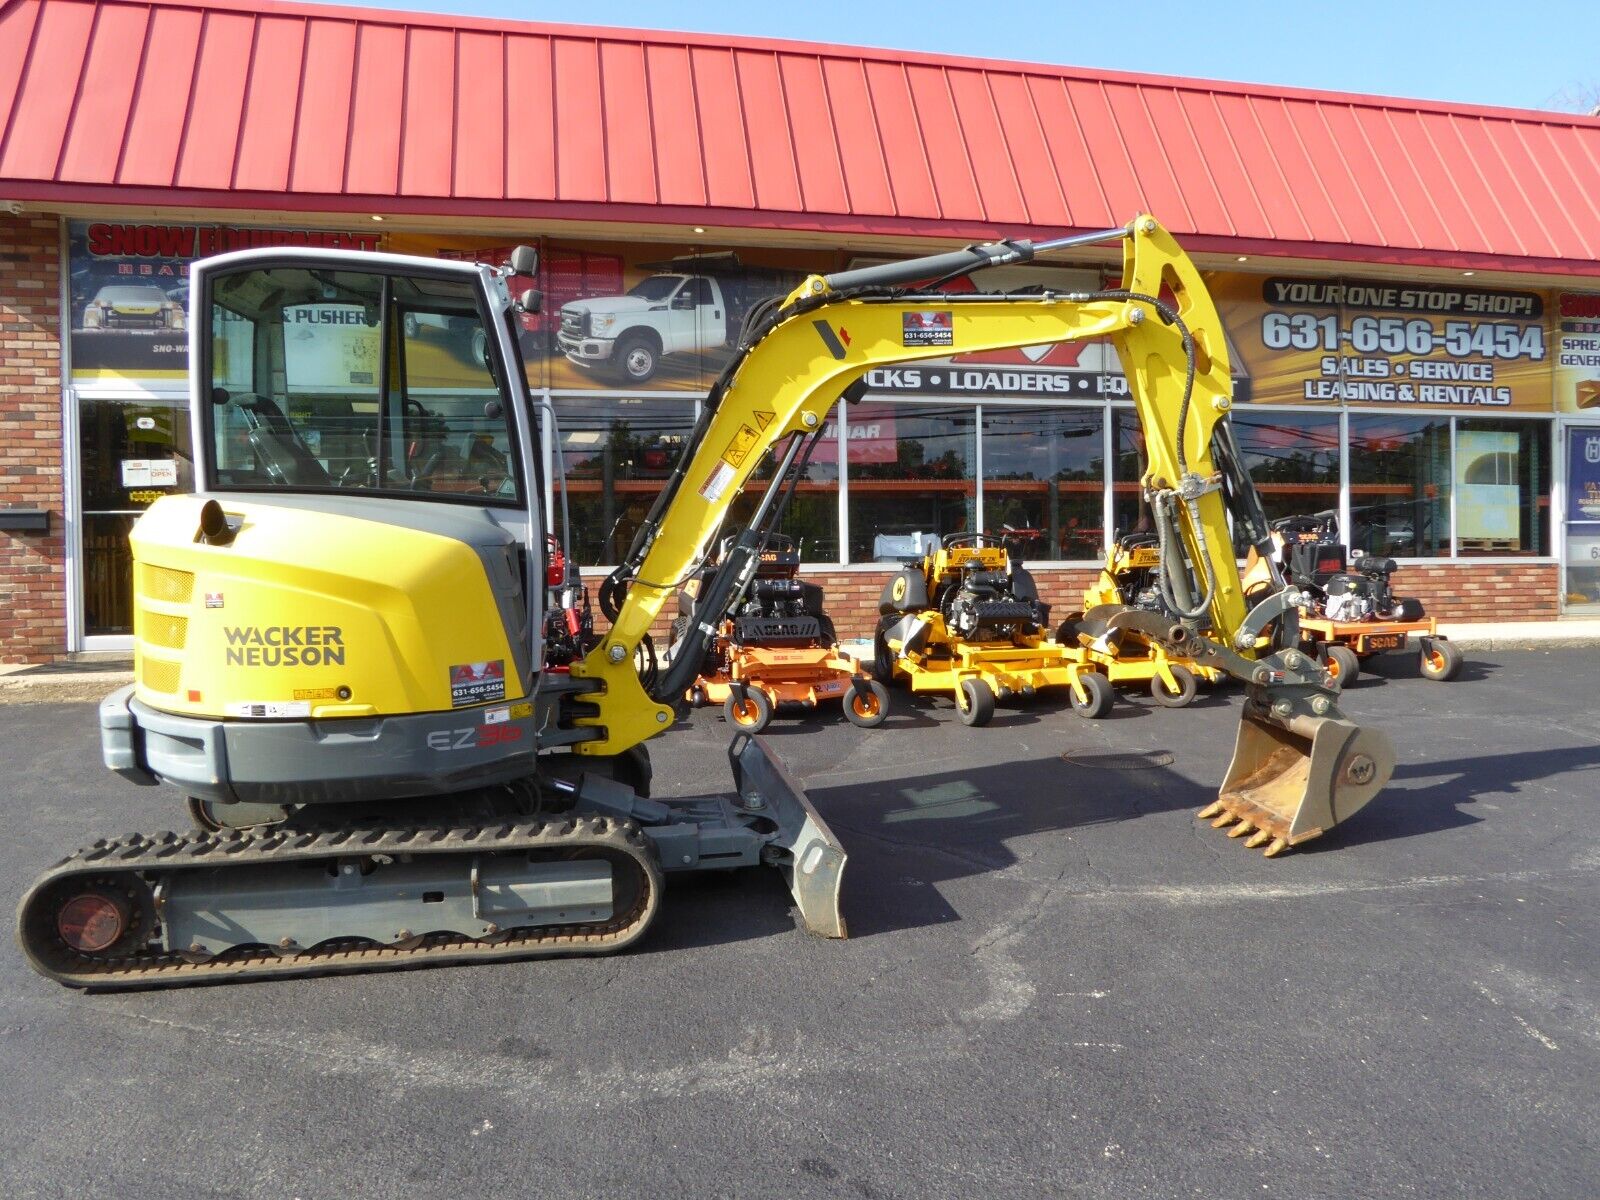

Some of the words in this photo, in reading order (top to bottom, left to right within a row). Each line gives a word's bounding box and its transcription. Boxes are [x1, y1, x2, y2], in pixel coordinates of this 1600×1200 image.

[88, 222, 196, 257] SNOW
[1274, 283, 1345, 304] YOUR
[1347, 287, 1397, 307] ONE
[1400, 290, 1461, 310] STOP
[1464, 294, 1533, 315] SHOP!
[1263, 312, 1545, 360] 631-656-5454
[863, 369, 921, 388] CKS
[950, 371, 1070, 392] LOADERS
[1321, 357, 1390, 377] SALES
[1410, 361, 1494, 381] SERVICE
[1304, 380, 1397, 401] LEASING
[1398, 384, 1416, 402] &
[1419, 385, 1510, 406] RENTALS
[223, 626, 345, 646] WACKER
[1370, 636, 1398, 649] SCAG
[226, 646, 345, 667] NEUSON
[453, 683, 504, 697] 631-656-5454
